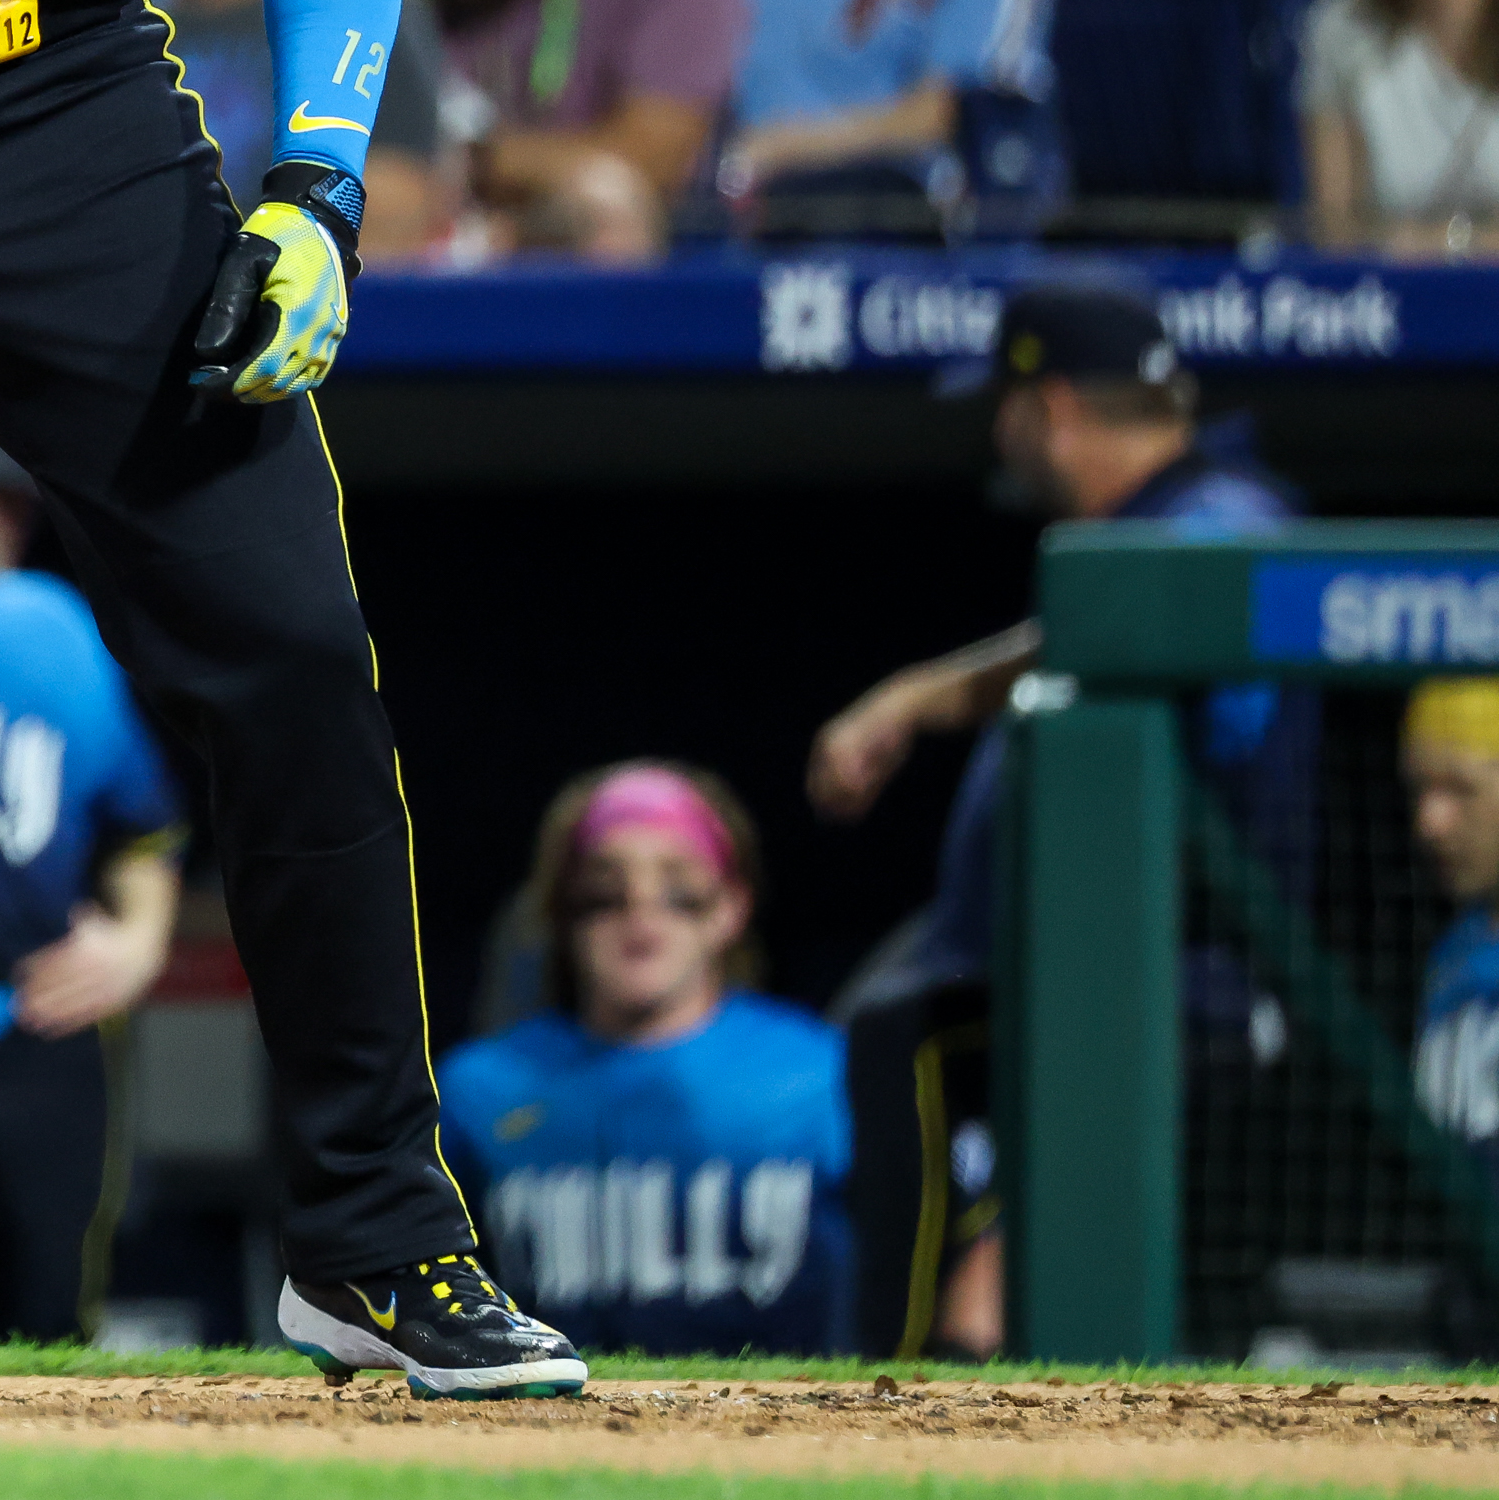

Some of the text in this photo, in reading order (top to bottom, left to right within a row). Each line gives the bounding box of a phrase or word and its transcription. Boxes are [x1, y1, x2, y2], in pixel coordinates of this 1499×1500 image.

[4, 11, 33, 51] 12
[332, 28, 387, 100] 12
[482, 1155, 814, 1309] PHILLY
